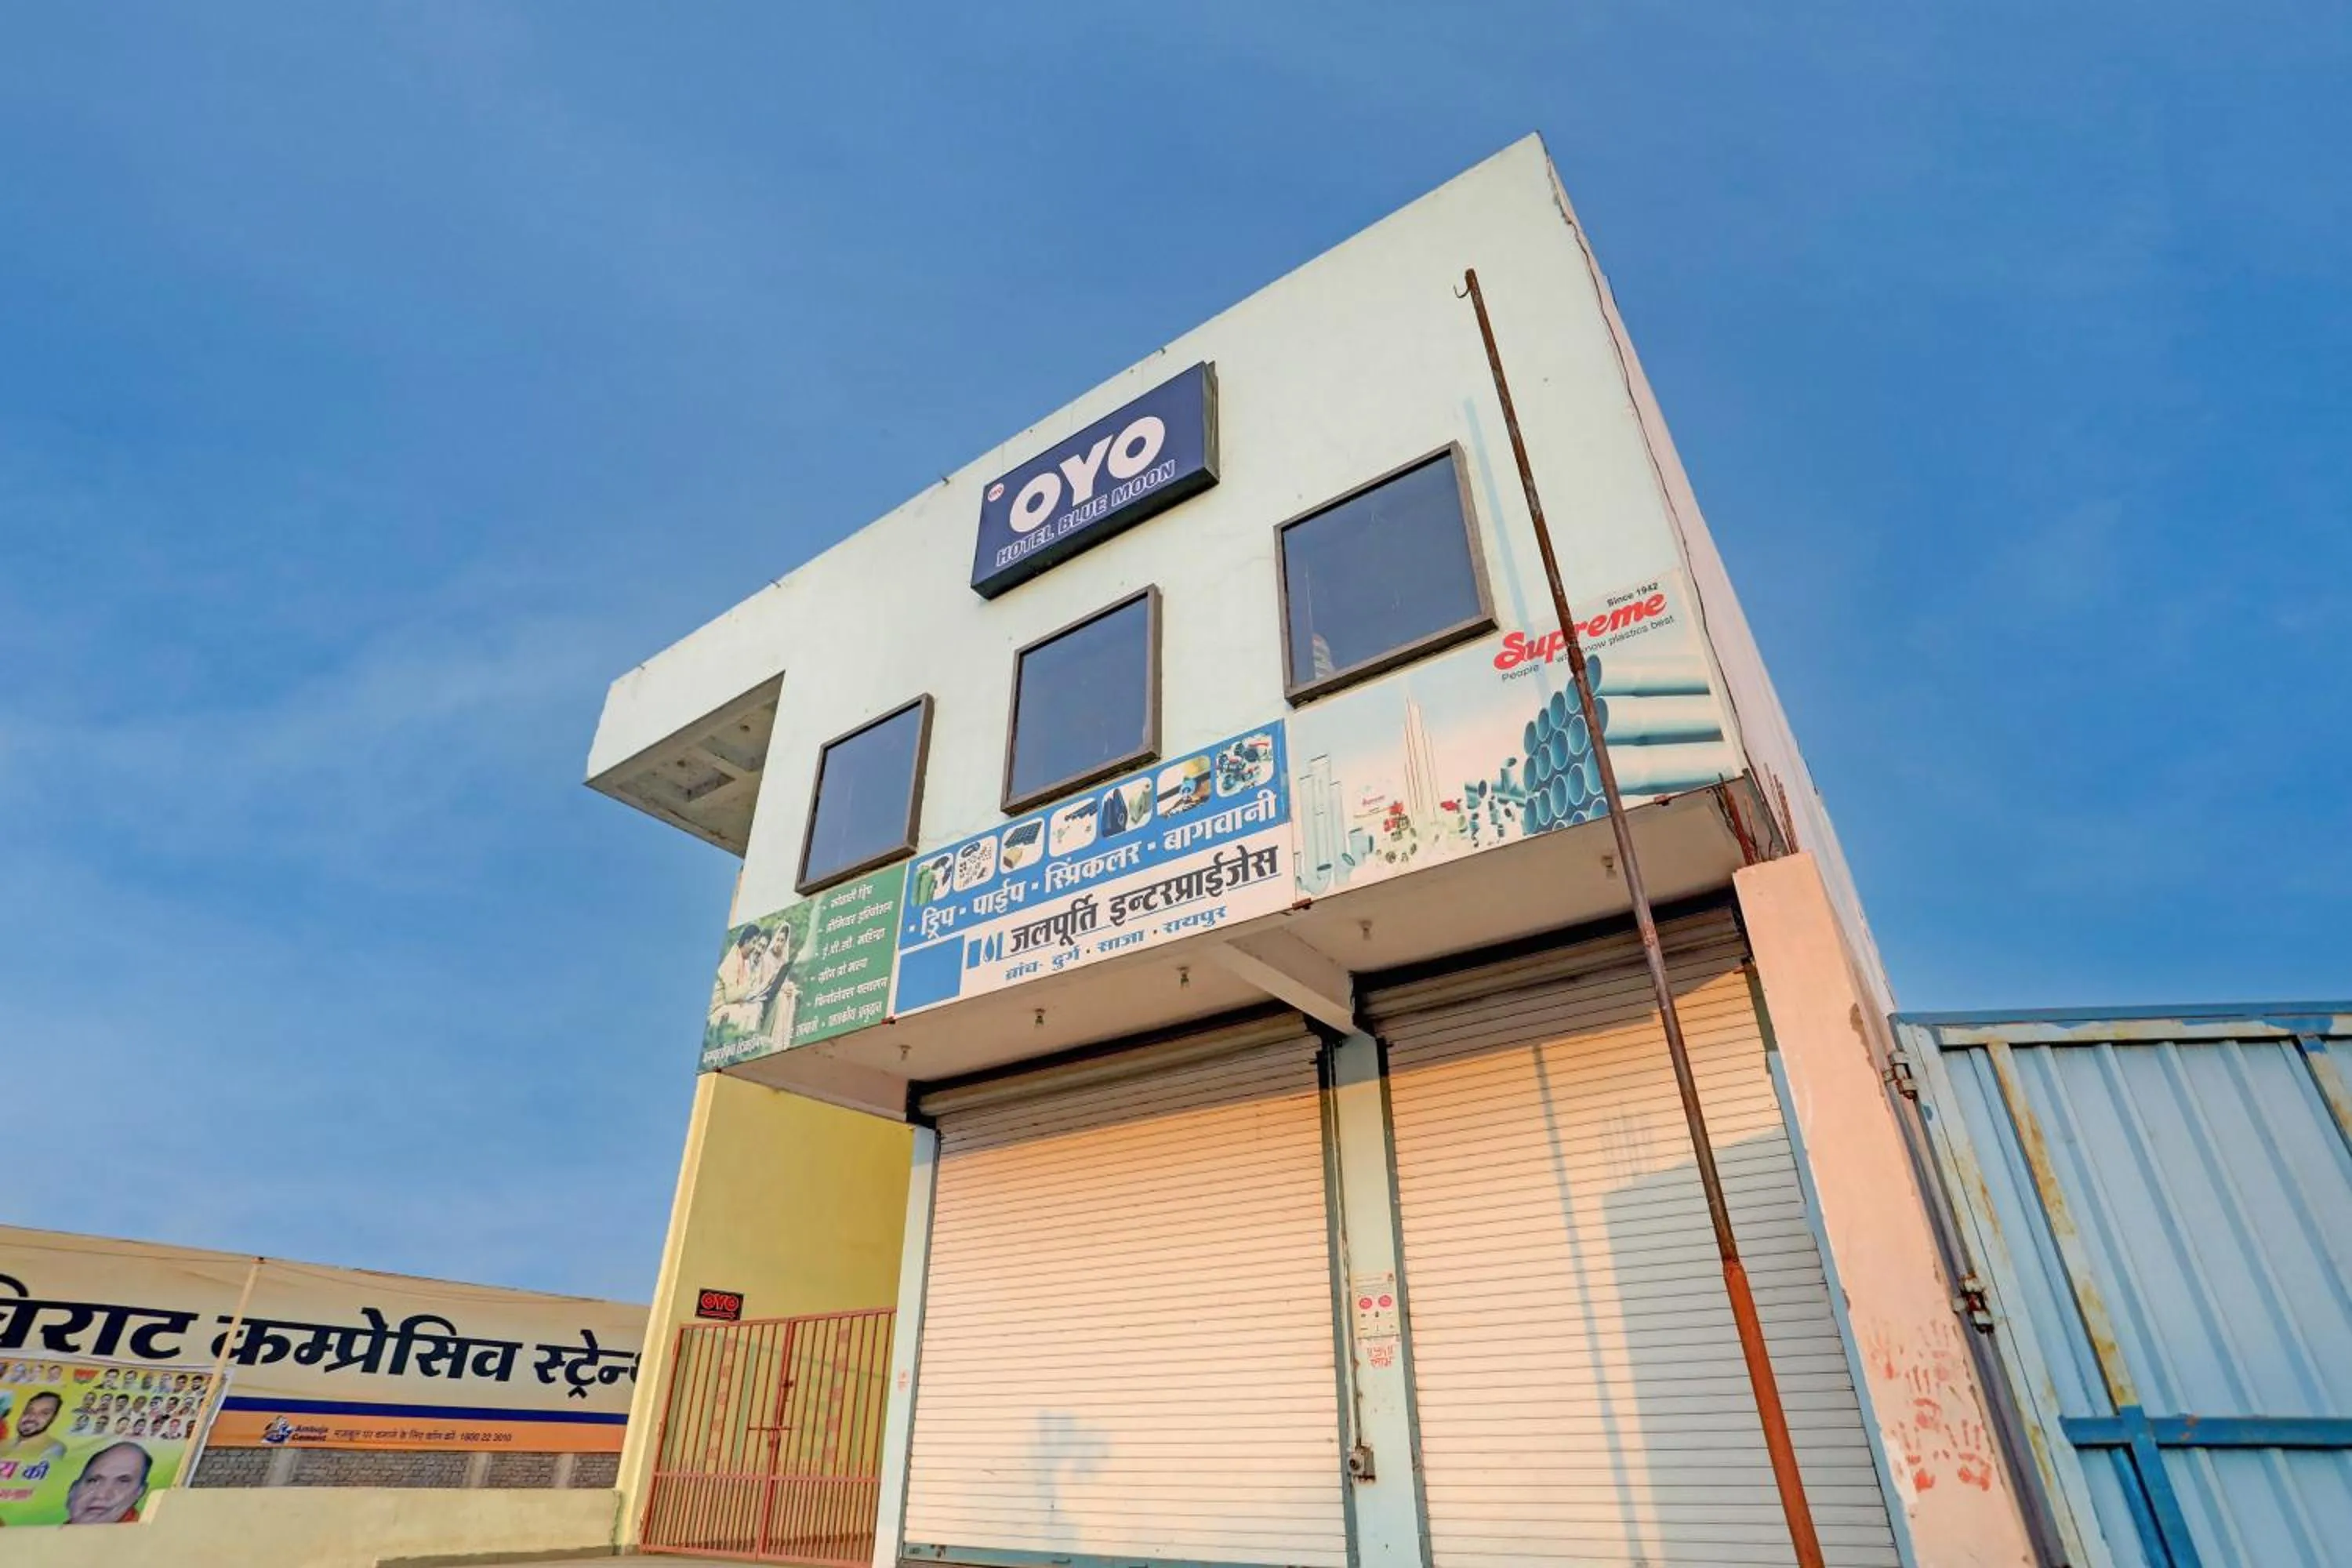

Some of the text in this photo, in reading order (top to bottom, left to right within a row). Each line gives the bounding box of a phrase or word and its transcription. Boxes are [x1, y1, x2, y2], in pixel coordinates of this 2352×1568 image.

[1009, 416, 1166, 533] OYO
[996, 459, 1176, 567] HOTEL BLUE MOON
[1494, 593, 1666, 670] Supreme
[1606, 591, 1634, 608] Since
[1501, 664, 1539, 681] People
[1581, 639, 1606, 654] now
[972, 880, 1025, 914] पाईप
[1163, 789, 1277, 851] बागवानी
[1010, 844, 1279, 953] जलपूर्ति इन्टरप्राईजेस
[1163, 905, 1227, 934] रायपुर
[701, 1292, 739, 1311] OYO
[532, 1329, 641, 1399] स्ट्रेन्
